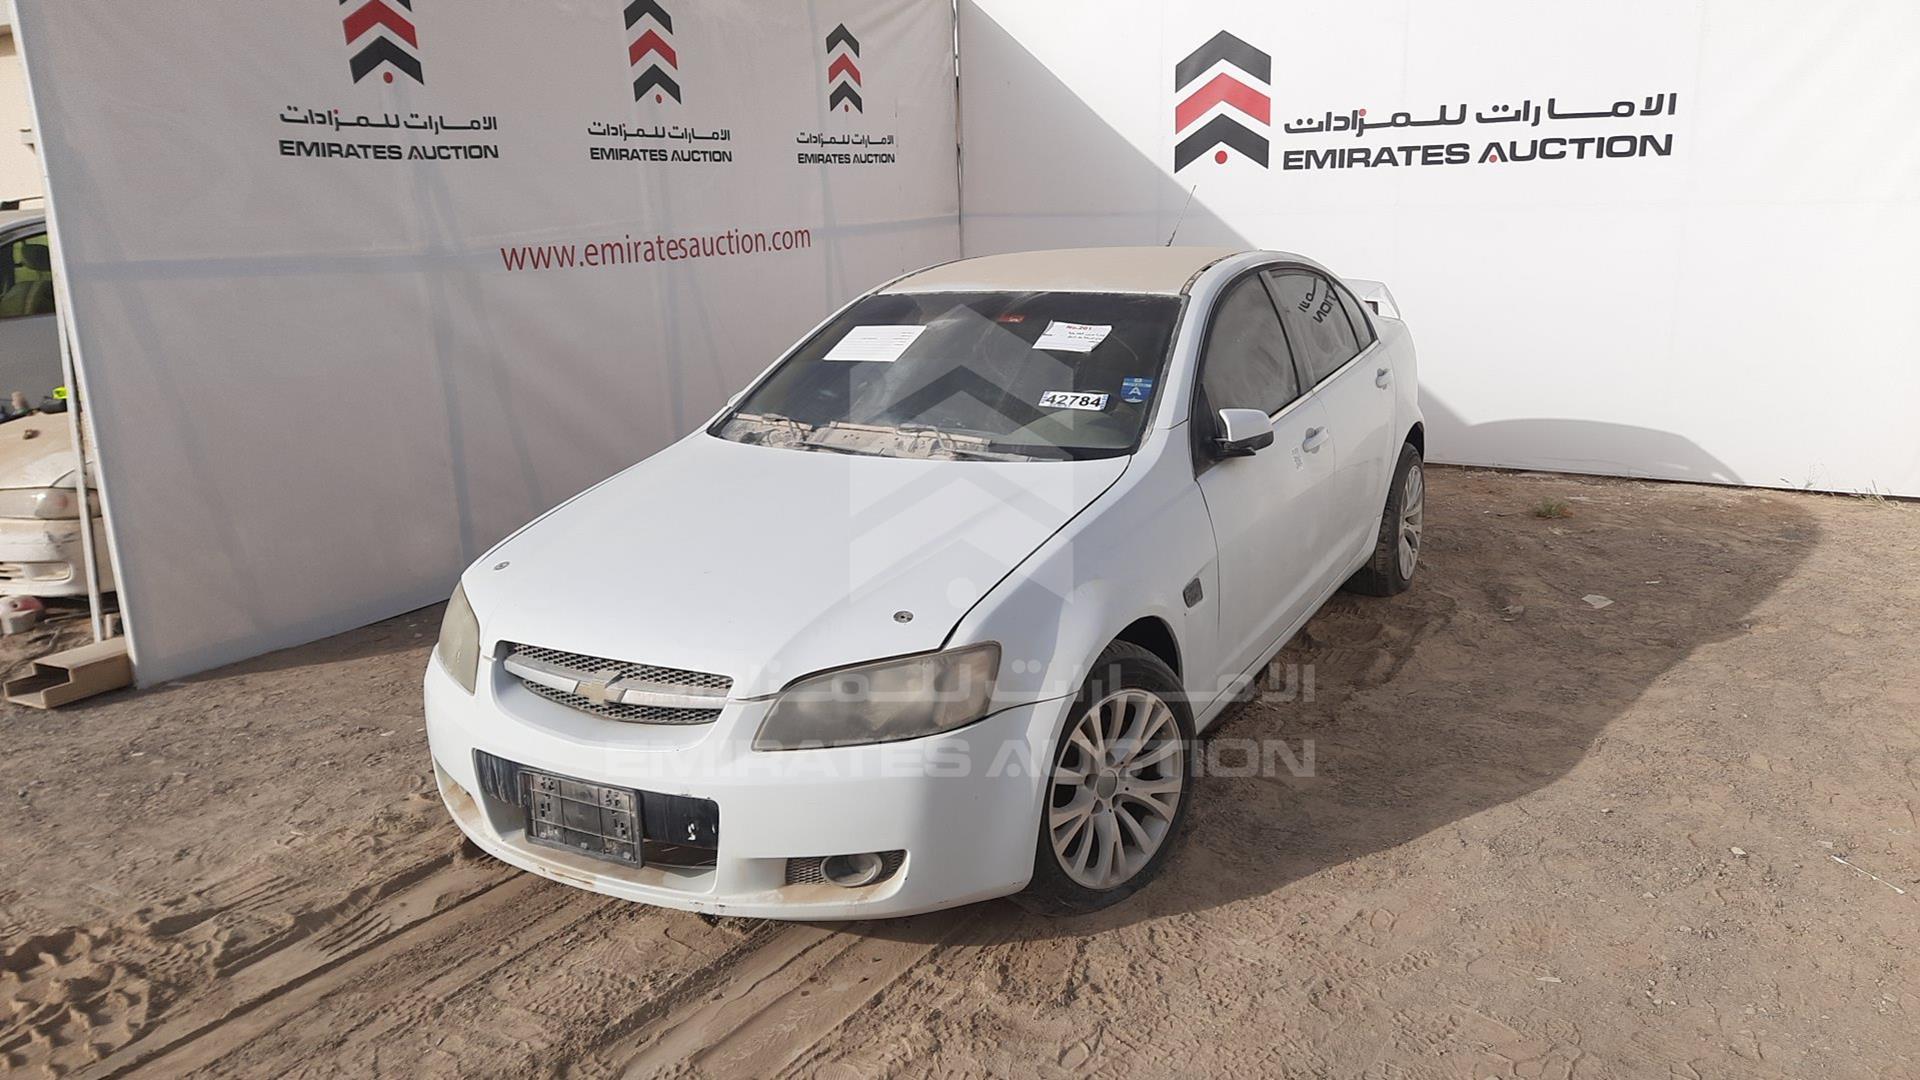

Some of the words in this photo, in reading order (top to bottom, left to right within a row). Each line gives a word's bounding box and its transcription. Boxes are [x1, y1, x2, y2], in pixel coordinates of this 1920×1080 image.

[278, 139, 402, 160] EMIRATES
[407, 144, 499, 160] AUCTION
[589, 147, 668, 162] EMIRATES
[670, 150, 733, 163] AUCTION
[798, 153, 851, 164] EMIRATES
[852, 153, 895, 164] AUCTION
[1282, 142, 1470, 170] EMIRATES
[1477, 133, 1673, 164] AUCTION
[500, 228, 812, 271] www.emiratesauction.com
[1045, 394, 1102, 408] 42784
